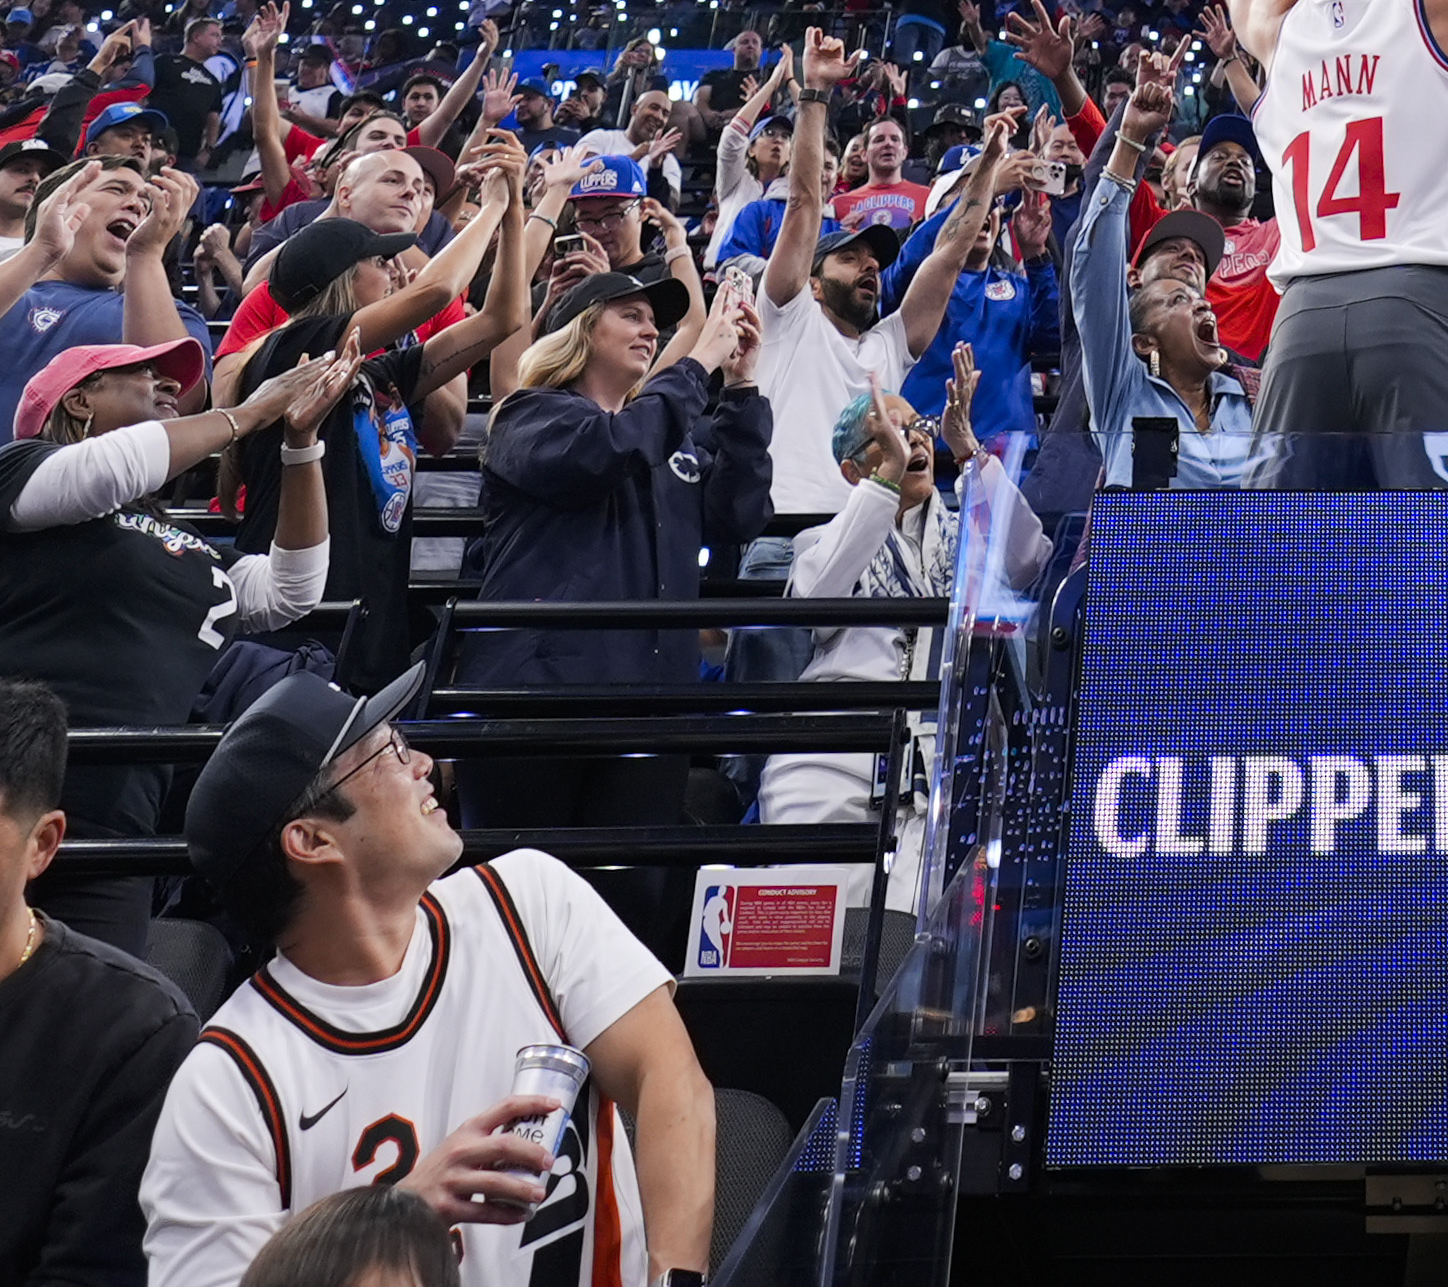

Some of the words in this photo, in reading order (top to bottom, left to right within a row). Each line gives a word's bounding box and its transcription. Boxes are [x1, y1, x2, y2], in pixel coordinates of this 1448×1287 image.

[1301, 54, 1381, 113] MANN
[959, 148, 971, 165] LA
[1282, 117, 1400, 253] 14
[865, 194, 916, 214] CLIPPERS
[390, 473, 409, 488] 33
